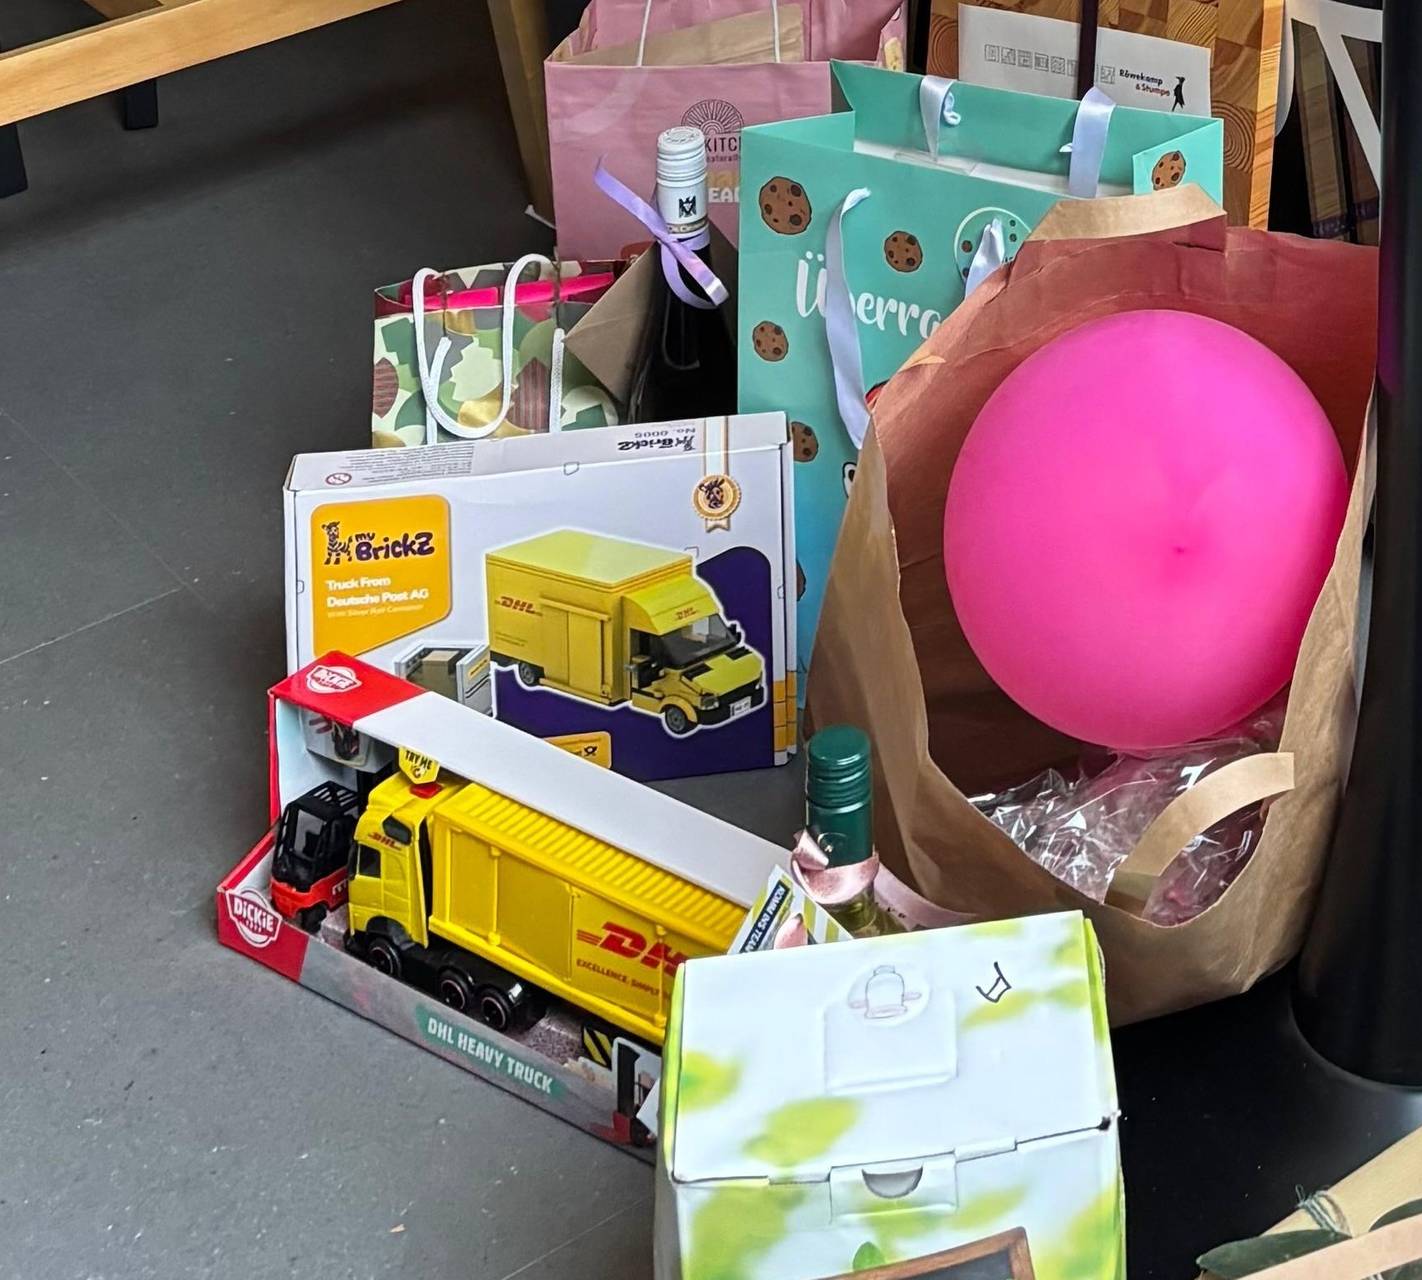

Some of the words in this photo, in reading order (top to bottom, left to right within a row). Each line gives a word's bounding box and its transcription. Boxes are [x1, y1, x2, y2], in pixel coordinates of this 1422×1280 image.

[326, 579, 359, 591] Truck
[360, 576, 391, 588] From
[327, 593, 381, 608] Deutsche
[381, 590, 409, 603] Post
[410, 588, 430, 600] AG
[502, 596, 536, 615] DHL
[427, 1017, 454, 1044] DHL
[457, 1032, 504, 1068] HEAVY
[505, 1056, 553, 1094] TRUCK
